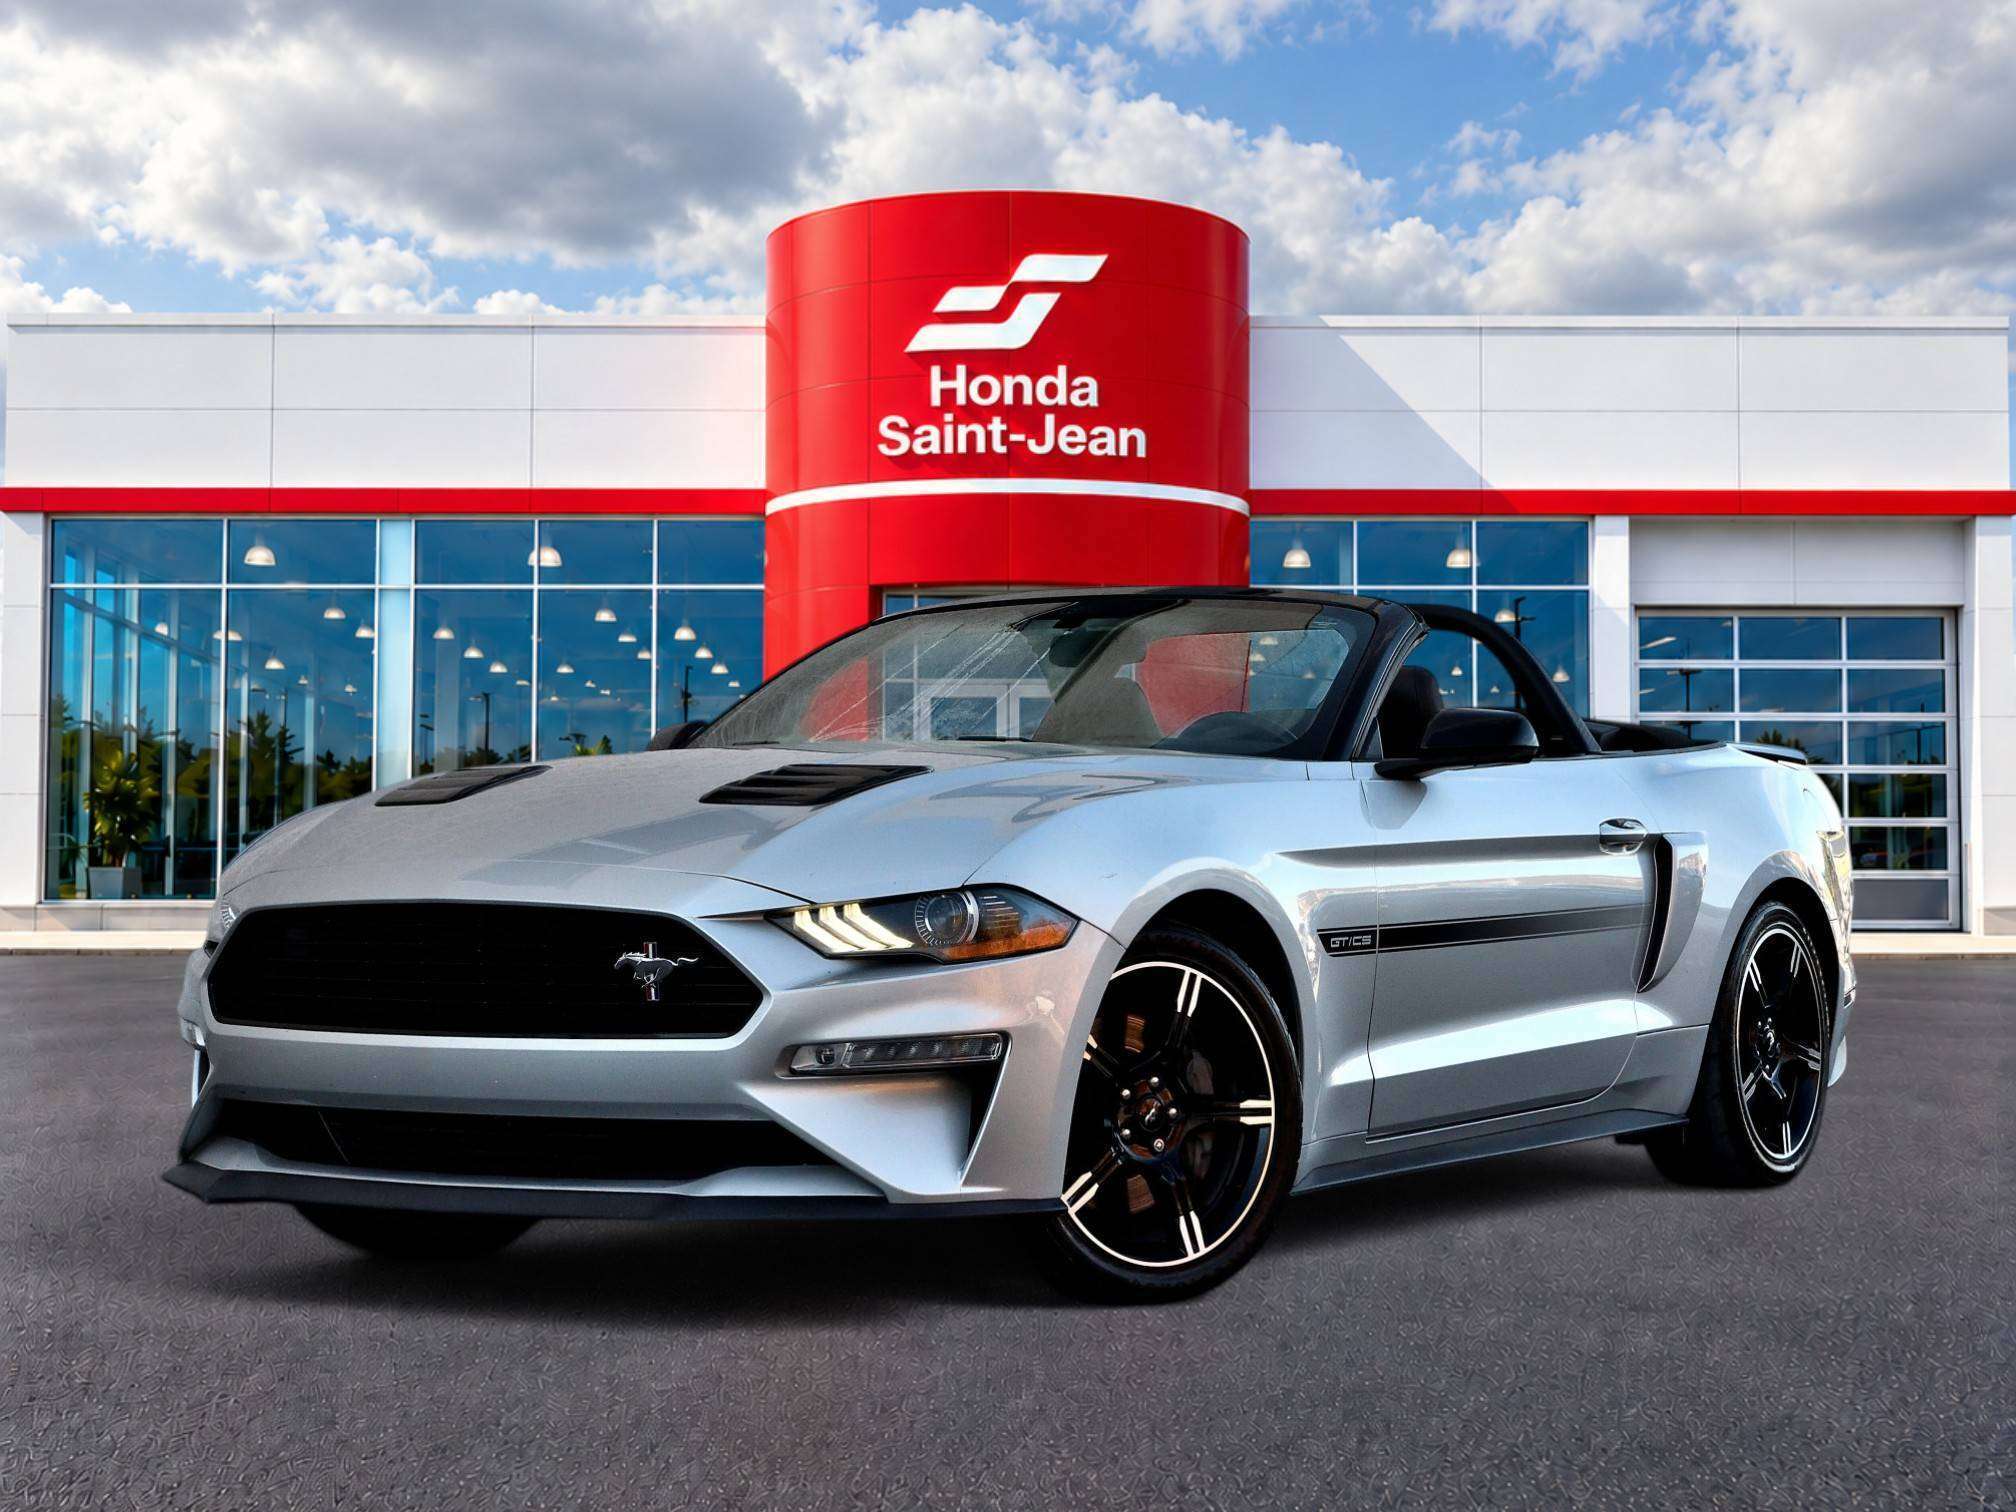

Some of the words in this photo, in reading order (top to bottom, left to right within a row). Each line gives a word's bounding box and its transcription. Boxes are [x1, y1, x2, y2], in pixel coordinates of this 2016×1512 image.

[930, 364, 1099, 407] Honda
[877, 413, 1147, 458] Saint-Jean
[1330, 935, 1372, 948] GT/CS
